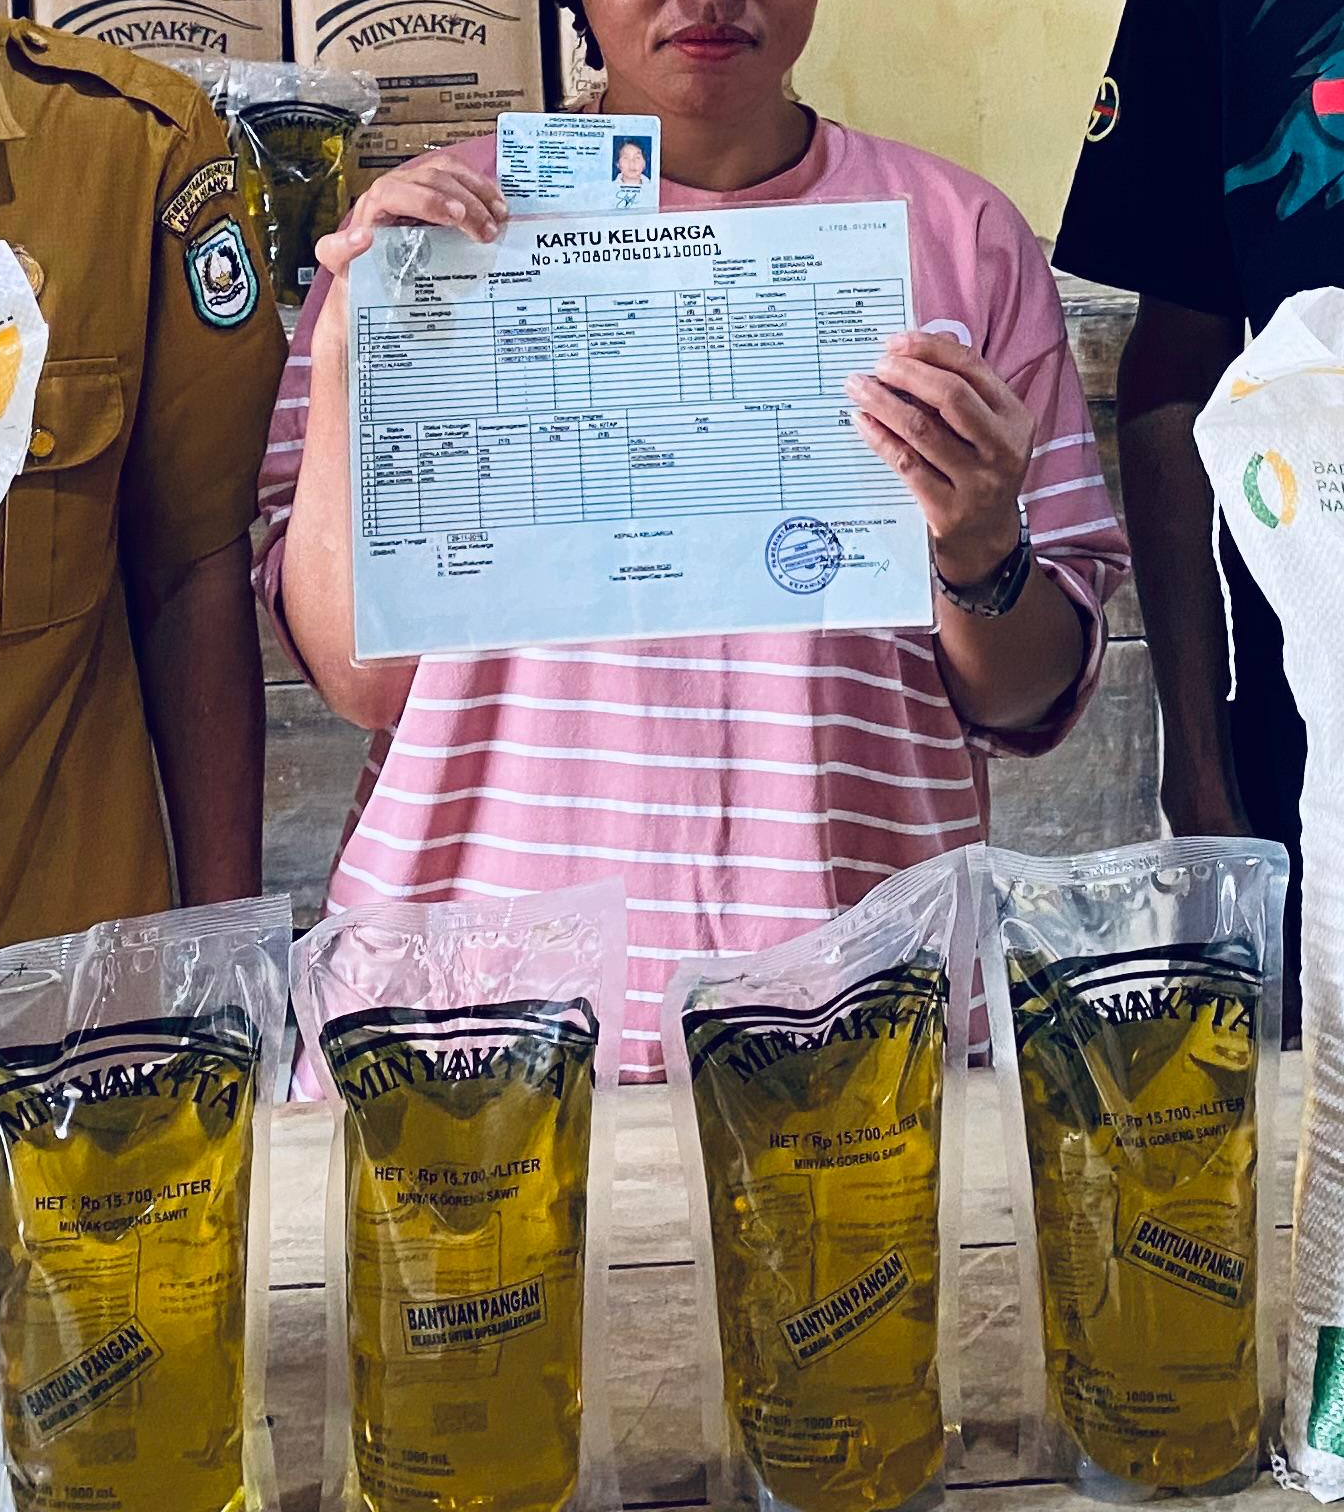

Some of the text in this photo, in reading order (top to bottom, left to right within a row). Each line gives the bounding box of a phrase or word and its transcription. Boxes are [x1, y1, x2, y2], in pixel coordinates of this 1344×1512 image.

[346, 14, 487, 53] MINYAKITA
[455, 100, 511, 109] STAND POUCH
[536, 224, 716, 249] KARTU KELUARGA
[770, 1133, 800, 1148] HET
[812, 1136, 832, 1149] Rp
[374, 1167, 405, 1181] HET
[419, 1169, 438, 1185] Rp
[35, 1196, 66, 1210] HET
[81, 1197, 100, 1212] Rp
[487, 1186, 519, 1202] SAWIT
[59, 1220, 99, 1233] MINYAK
[155, 1208, 189, 1223] SAWIT
[1136, 1220, 1244, 1282] BANTUAN PANGAN
[407, 1283, 540, 1331] BANTUAN PANGAN
[786, 1253, 903, 1345] BANTUAN PANGAN
[26, 1367, 86, 1416] BANTUAN
[80, 1325, 144, 1382] PANGAN
